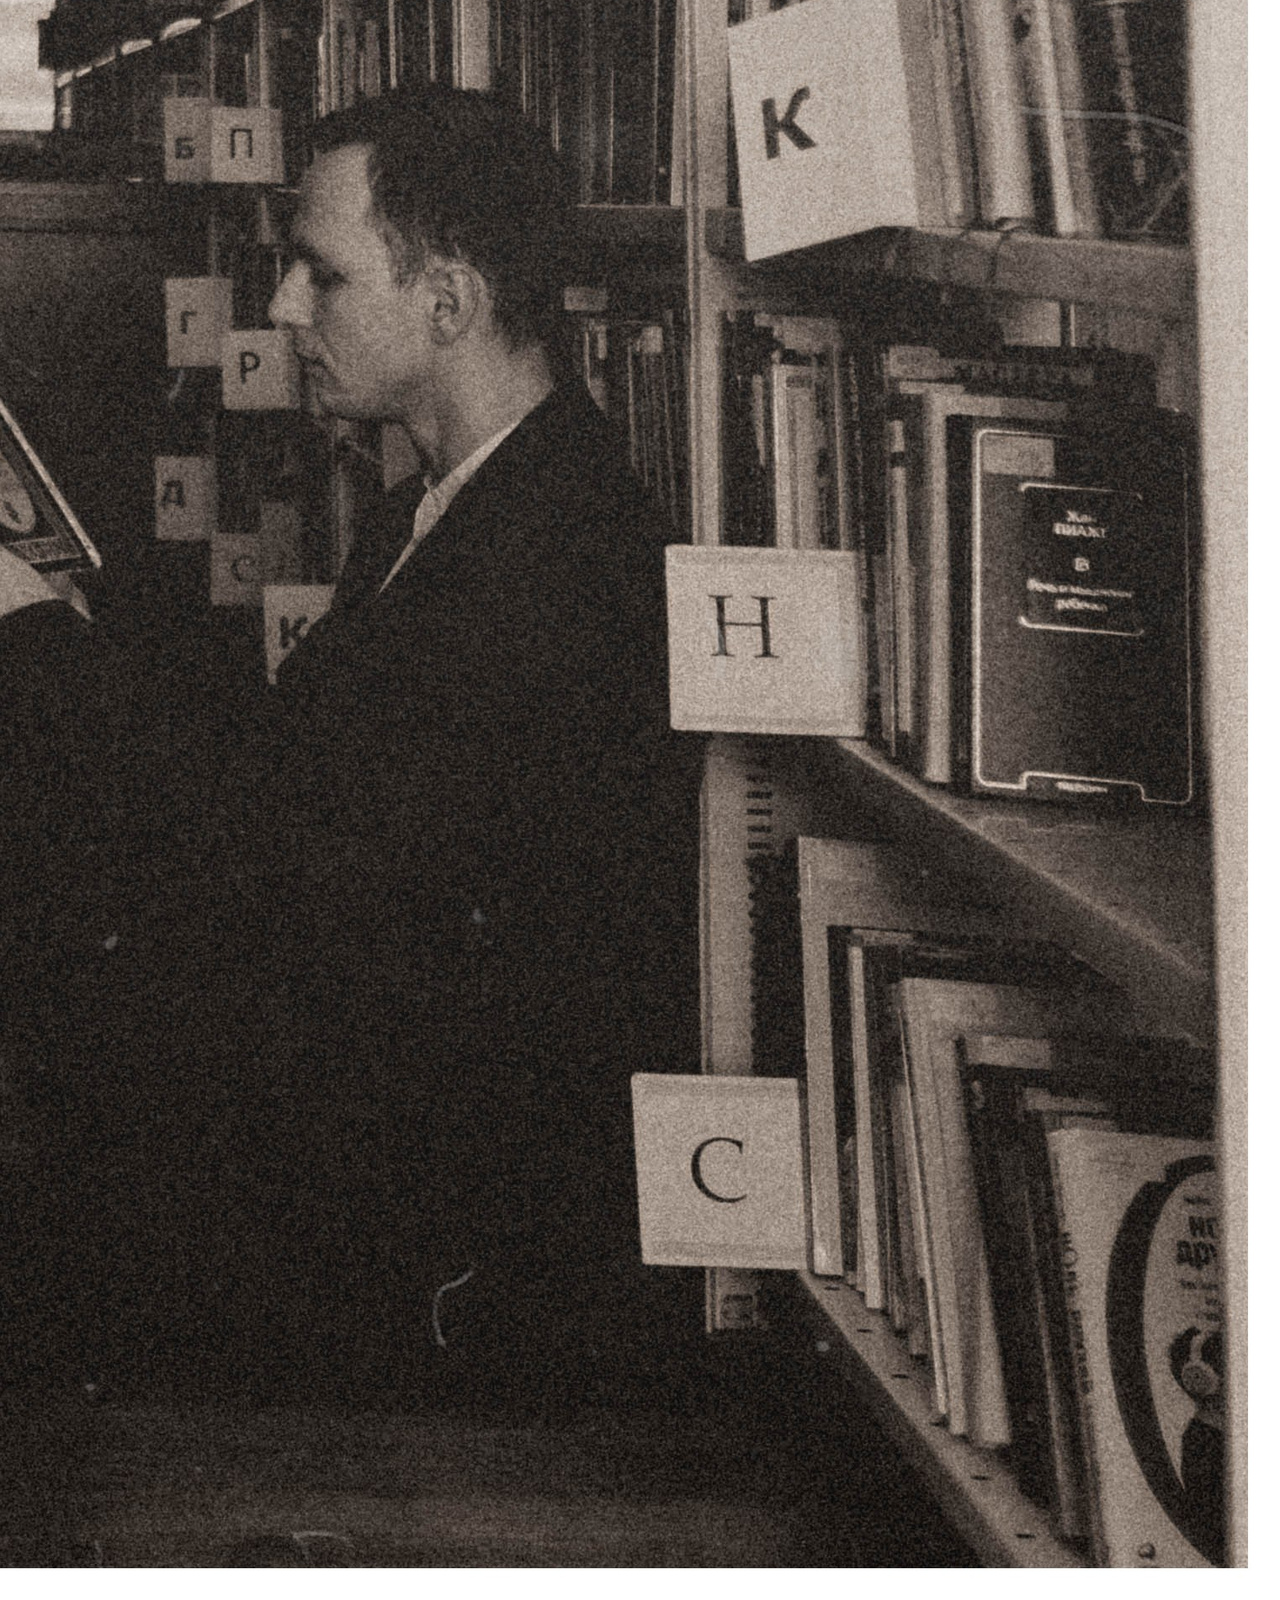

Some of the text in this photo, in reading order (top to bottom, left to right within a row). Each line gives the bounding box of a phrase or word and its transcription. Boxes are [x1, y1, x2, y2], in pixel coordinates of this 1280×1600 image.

[761, 86, 817, 161] К
[175, 137, 195, 160] Б
[230, 128, 254, 159] П
[181, 311, 197, 335] Г
[240, 350, 261, 384] Р
[280, 614, 308, 649] К
[708, 594, 780, 659] Н
[690, 1136, 748, 1204] С
